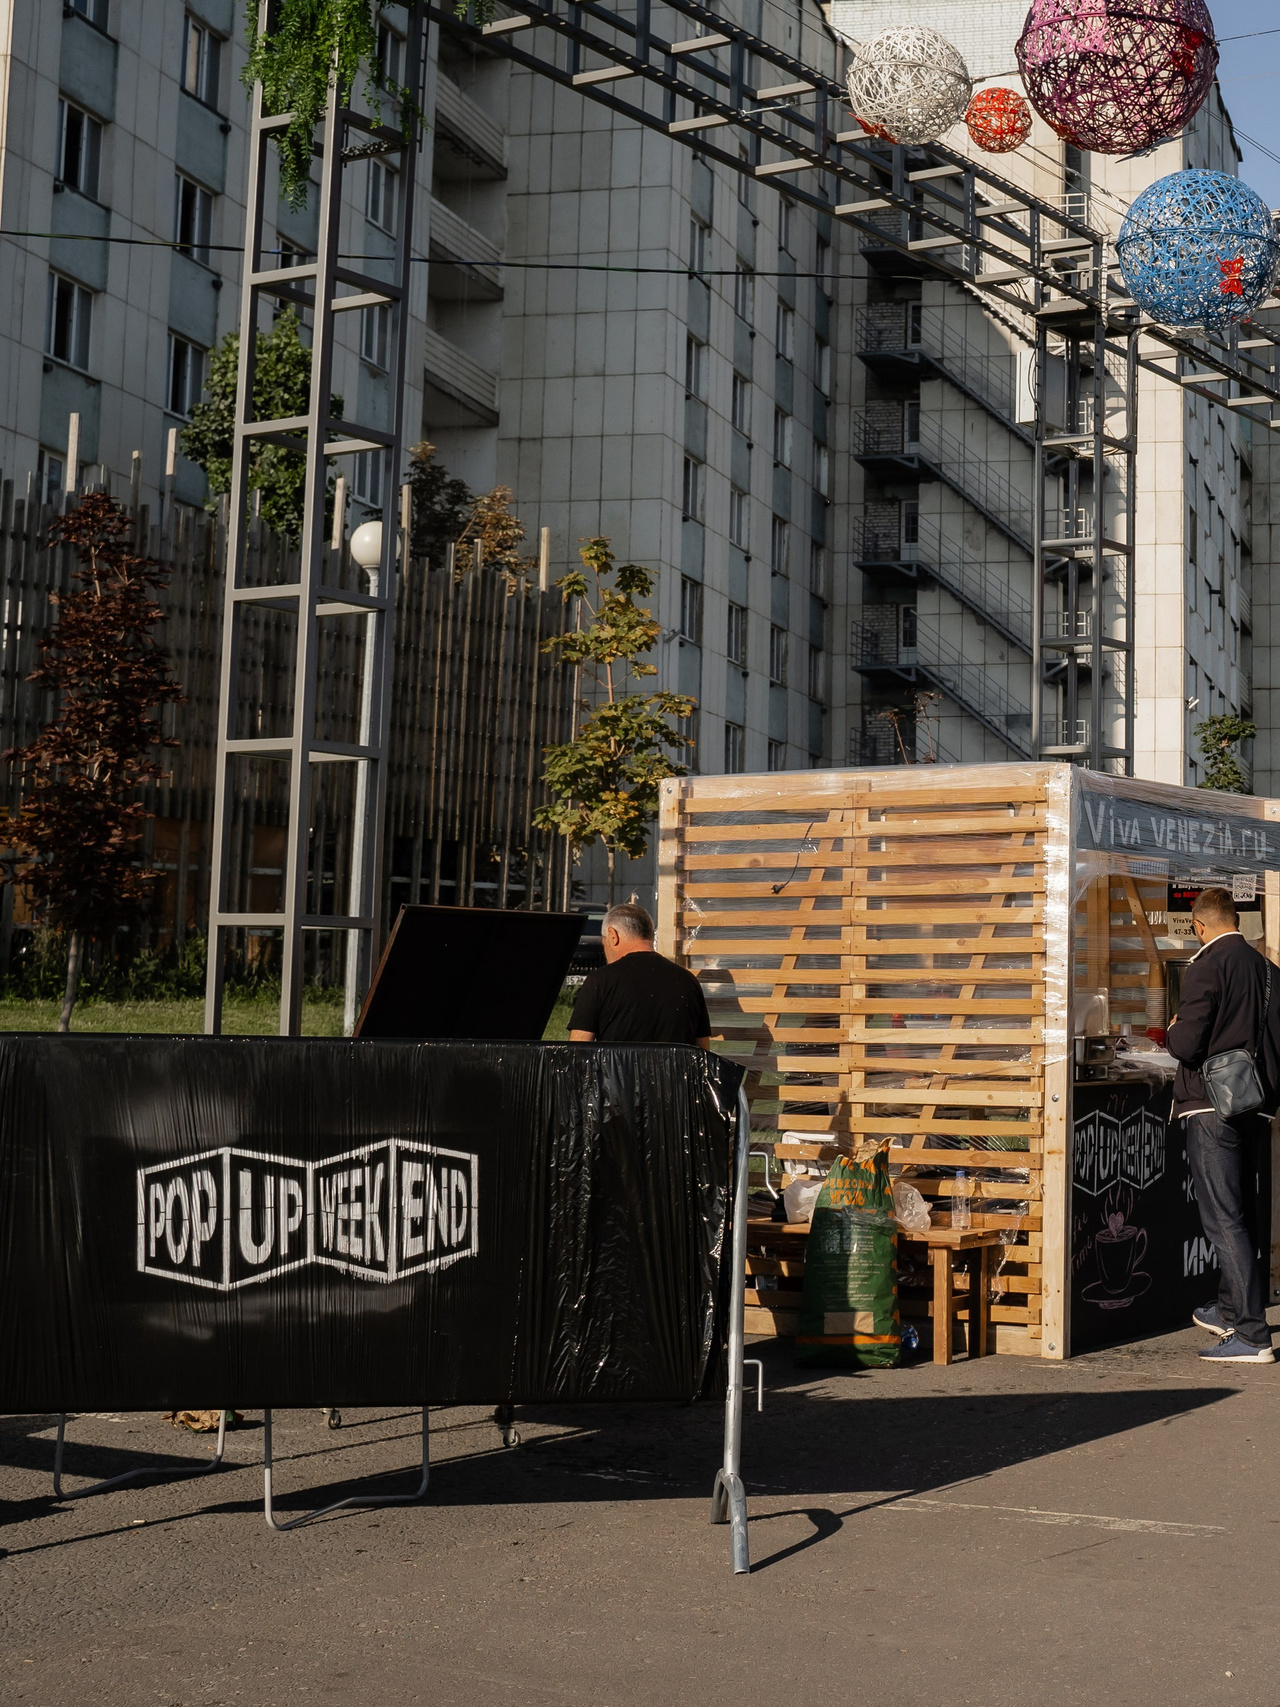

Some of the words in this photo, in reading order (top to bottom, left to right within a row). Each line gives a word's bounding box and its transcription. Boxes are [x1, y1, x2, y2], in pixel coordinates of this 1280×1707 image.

[1174, 928, 1192, 936] 47-33
[1074, 1123, 1095, 1181] POP
[1099, 1125, 1118, 1181] UP
[1144, 1121, 1163, 1181] END
[149, 1169, 217, 1267] POP
[239, 1168, 303, 1264] UP
[320, 1162, 385, 1264] WEEK
[402, 1160, 468, 1259] END
